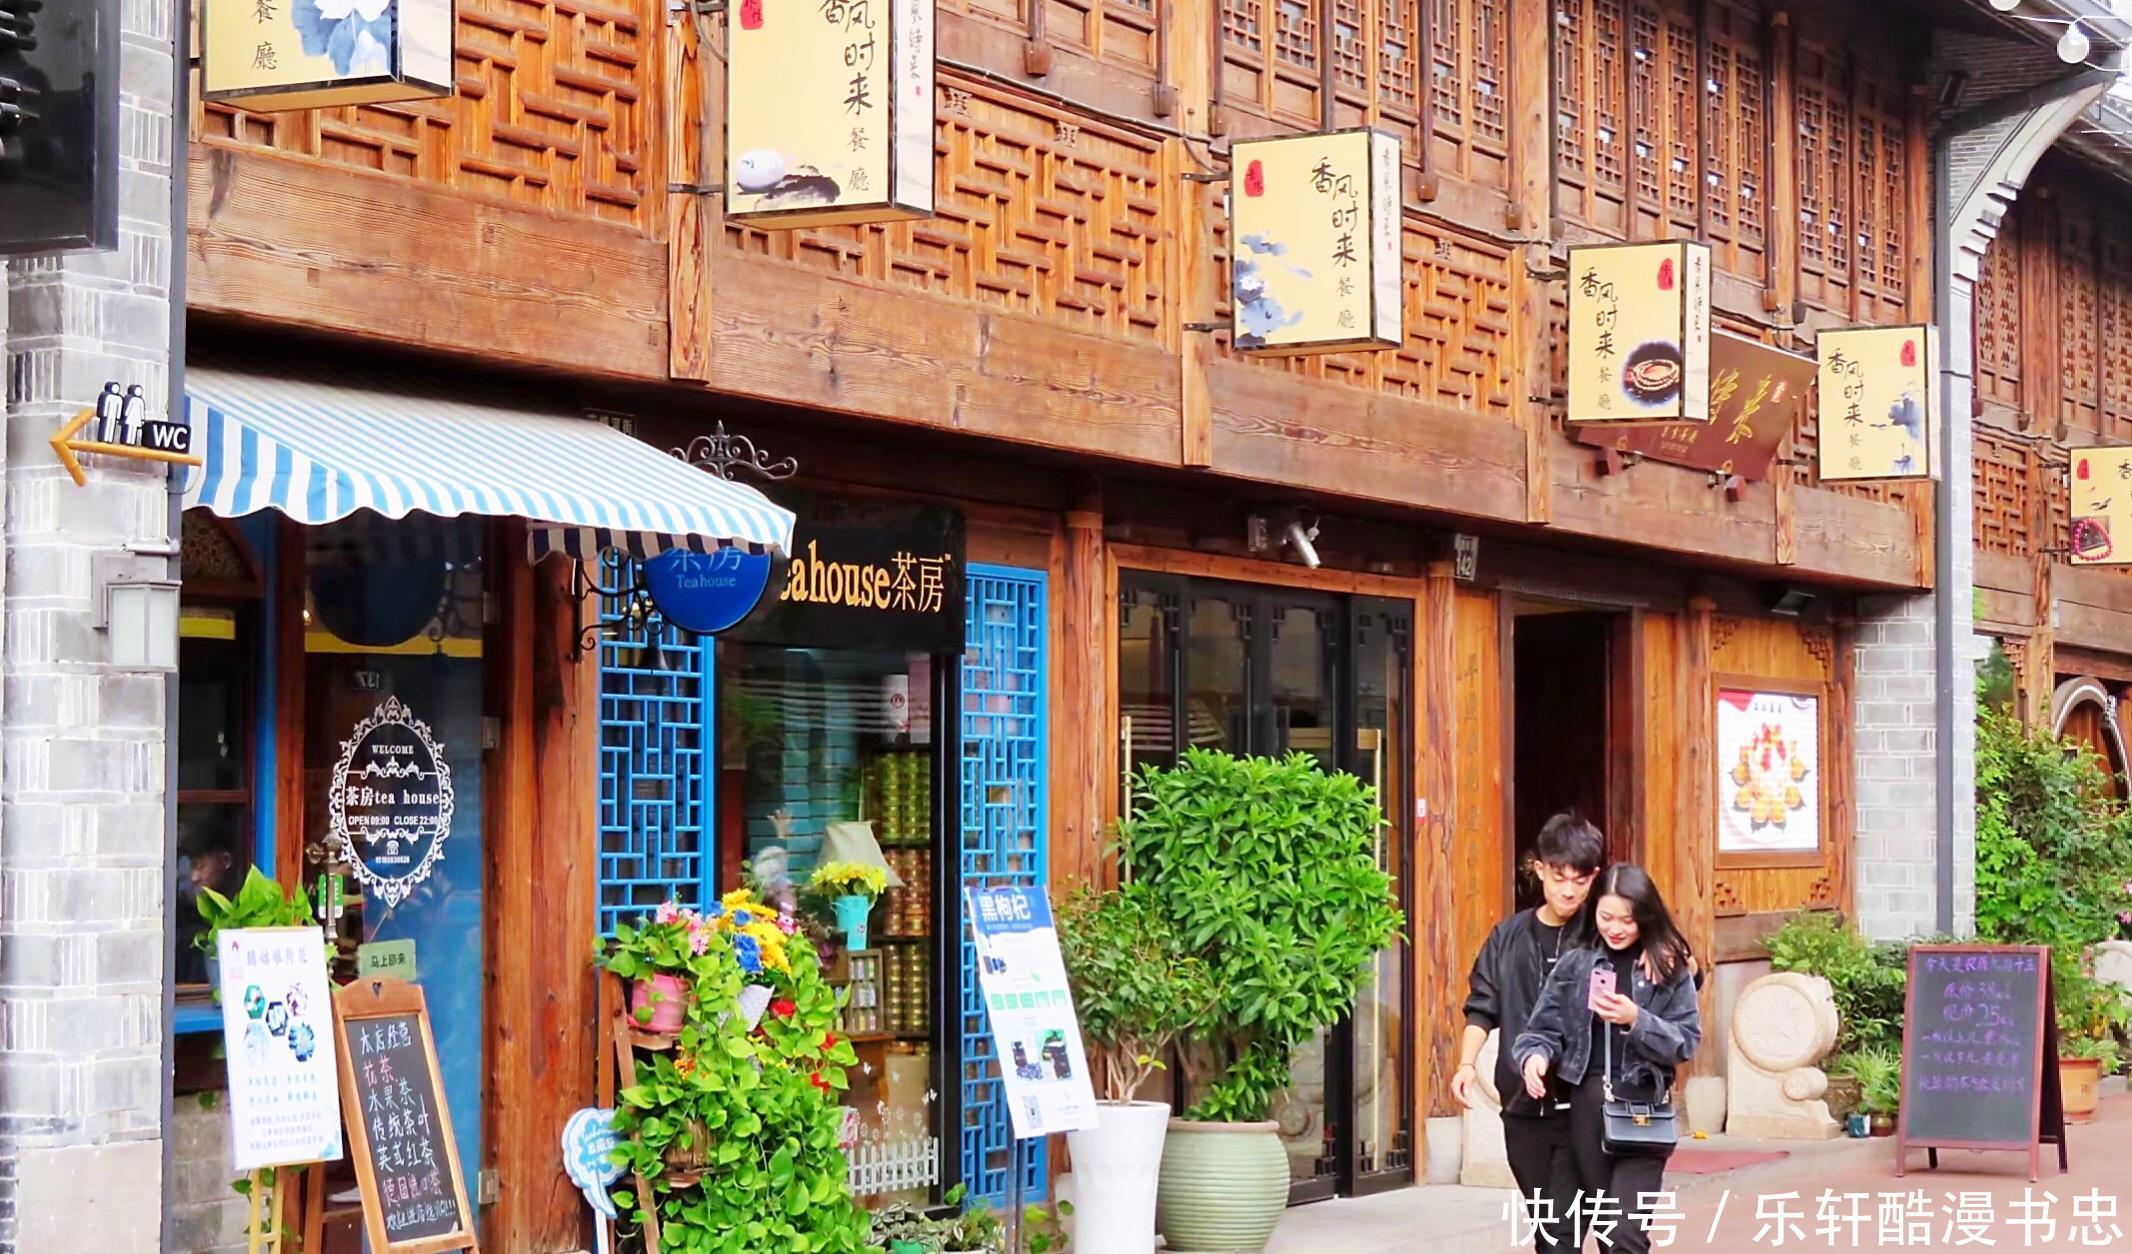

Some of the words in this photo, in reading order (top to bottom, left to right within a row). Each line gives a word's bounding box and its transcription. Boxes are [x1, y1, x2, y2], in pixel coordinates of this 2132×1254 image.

[1309, 156, 1358, 268] 香风时来
[1580, 266, 1618, 358] 香风时来
[1827, 347, 1864, 427] 香风时来
[152, 424, 188, 450] WC
[676, 573, 737, 588] Teahouse
[371, 744, 414, 755] WELCOME
[403, 789, 439, 805] house
[348, 815, 369, 826] OPEN
[393, 815, 419, 826] CLOSE
[980, 893, 1032, 923] 黑枸杞
[370, 953, 407, 968] 马上回来
[359, 1021, 412, 1055] 本店经营
[369, 1077, 417, 1113] 水果茶
[373, 1093, 430, 1141] 传统茶叶
[377, 1136, 437, 1173] 英式红茶
